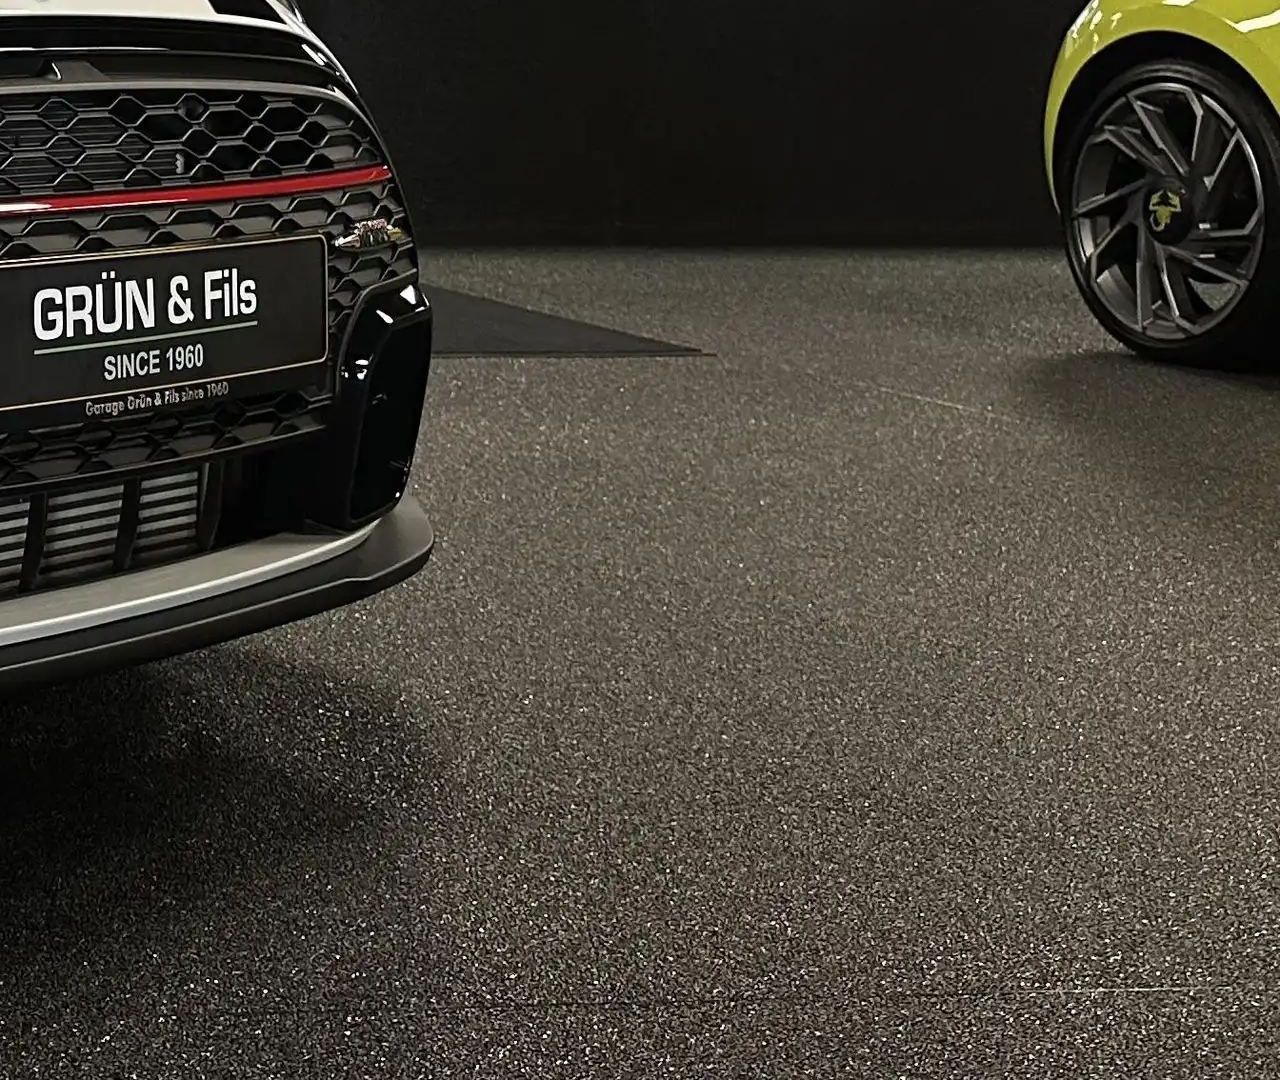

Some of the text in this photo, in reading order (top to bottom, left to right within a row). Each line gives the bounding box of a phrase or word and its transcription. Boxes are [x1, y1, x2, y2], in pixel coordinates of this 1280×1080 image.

[33, 268, 258, 341] GRÜN & Fils
[103, 343, 204, 381] SINCE 1960
[85, 381, 229, 416] Garage Grün & Fils since 1960
